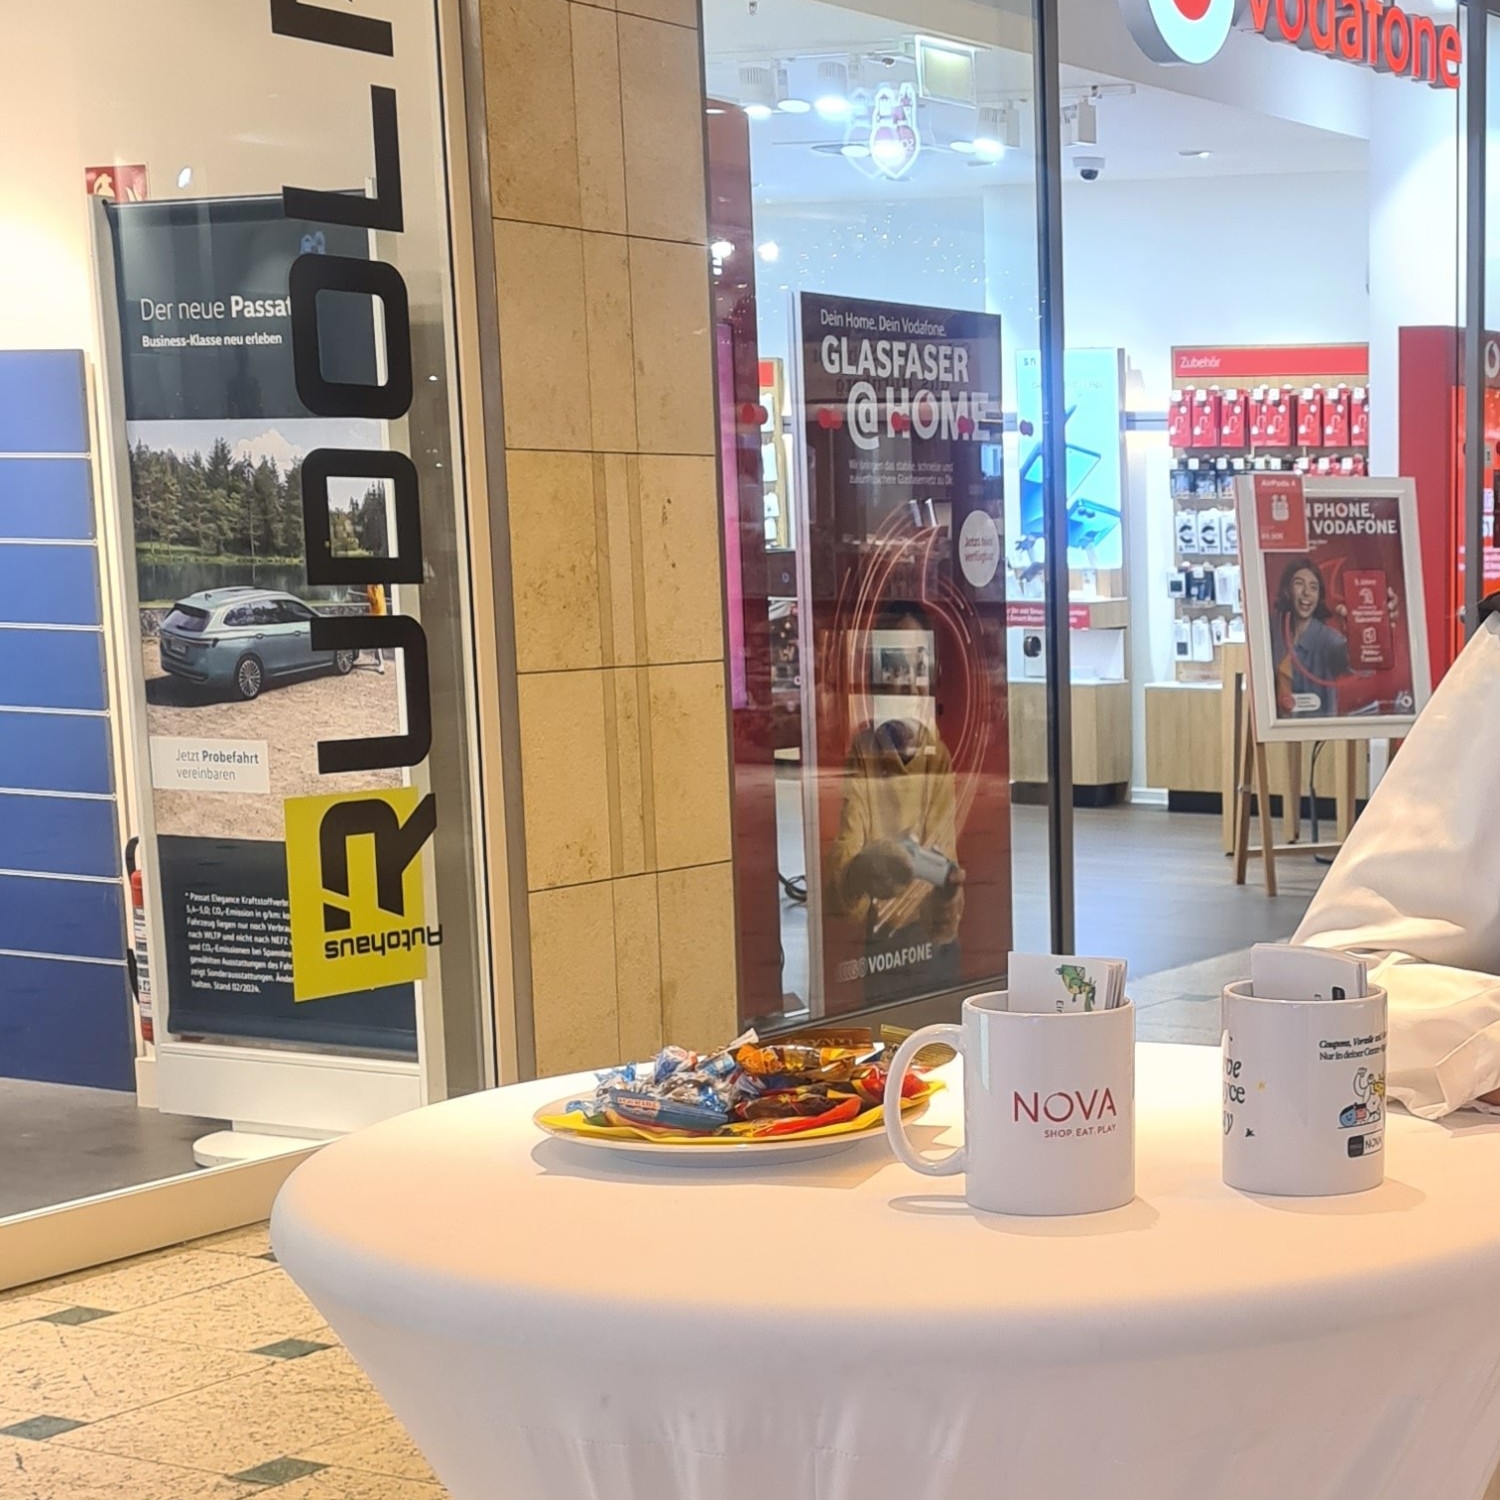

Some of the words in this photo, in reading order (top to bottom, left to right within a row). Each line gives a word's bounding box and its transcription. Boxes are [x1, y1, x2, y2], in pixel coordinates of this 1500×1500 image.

[140, 298, 173, 321] Der
[178, 300, 225, 319] neue
[820, 308, 844, 327] Dein
[845, 312, 877, 331] Home.
[879, 315, 901, 332] Dein
[902, 317, 947, 337] Vodafone.
[141, 334, 222, 348] Business-Klasse
[223, 336, 244, 346] neu
[245, 332, 283, 345] erleben
[821, 334, 969, 383] GLASFASER
[1180, 356, 1221, 369] Zubehör
[1313, 502, 1375, 520] PHONE,
[1312, 519, 1398, 535] VODAFONE
[176, 748, 199, 762] Jetzt
[201, 750, 259, 764] Probefahrt
[177, 767, 236, 781] vereinbaren
[241, 896, 290, 908] Kraftstoffverbr
[324, 924, 443, 960] Autohaus
[868, 942, 933, 974] VODAFONE
[1319, 1051, 1334, 1061] Nur
[1013, 1087, 1117, 1123] NOVA
